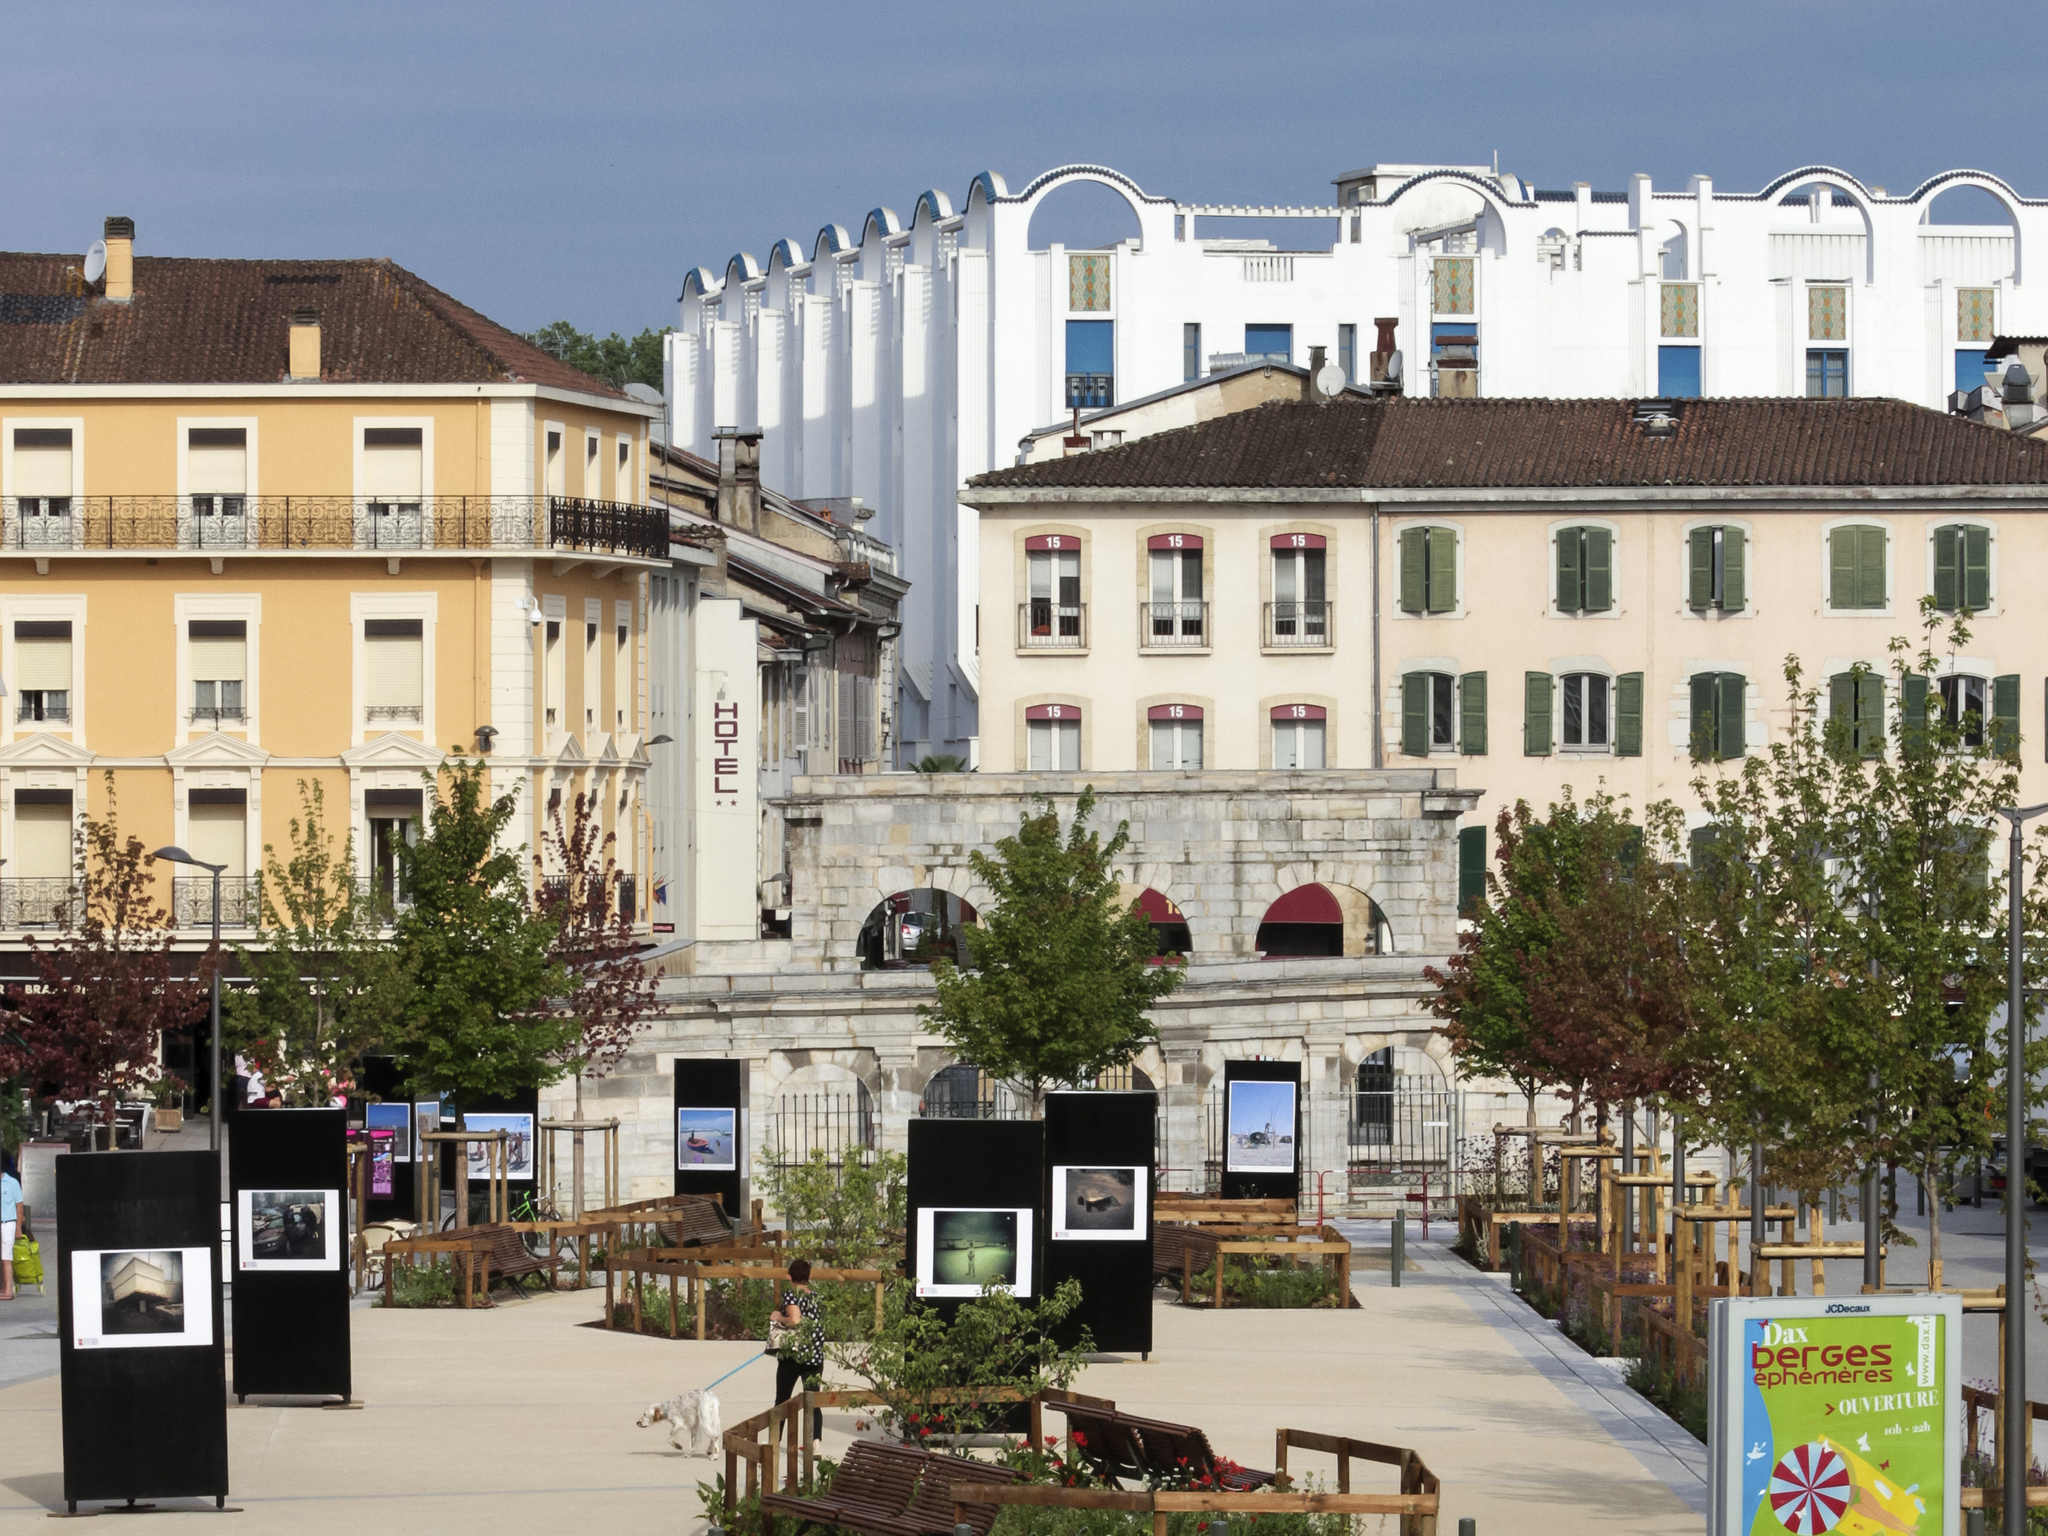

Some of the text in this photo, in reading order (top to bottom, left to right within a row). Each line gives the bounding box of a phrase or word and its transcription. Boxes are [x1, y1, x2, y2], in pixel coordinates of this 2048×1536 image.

[1046, 537, 1060, 548] 15
[1168, 535, 1182, 547] 15
[1292, 535, 1305, 546] 15
[1047, 706, 1060, 718] 15
[1169, 706, 1183, 718] 15
[1292, 706, 1306, 717] 15
[714, 702, 738, 793] HOTEL
[1825, 1304, 1870, 1313] JCDecaux
[1762, 1322, 1808, 1346] Dax
[1752, 1342, 1892, 1369] berges
[1753, 1367, 1893, 1389] éphémères
[1839, 1389, 1939, 1415] OUVERTURE
